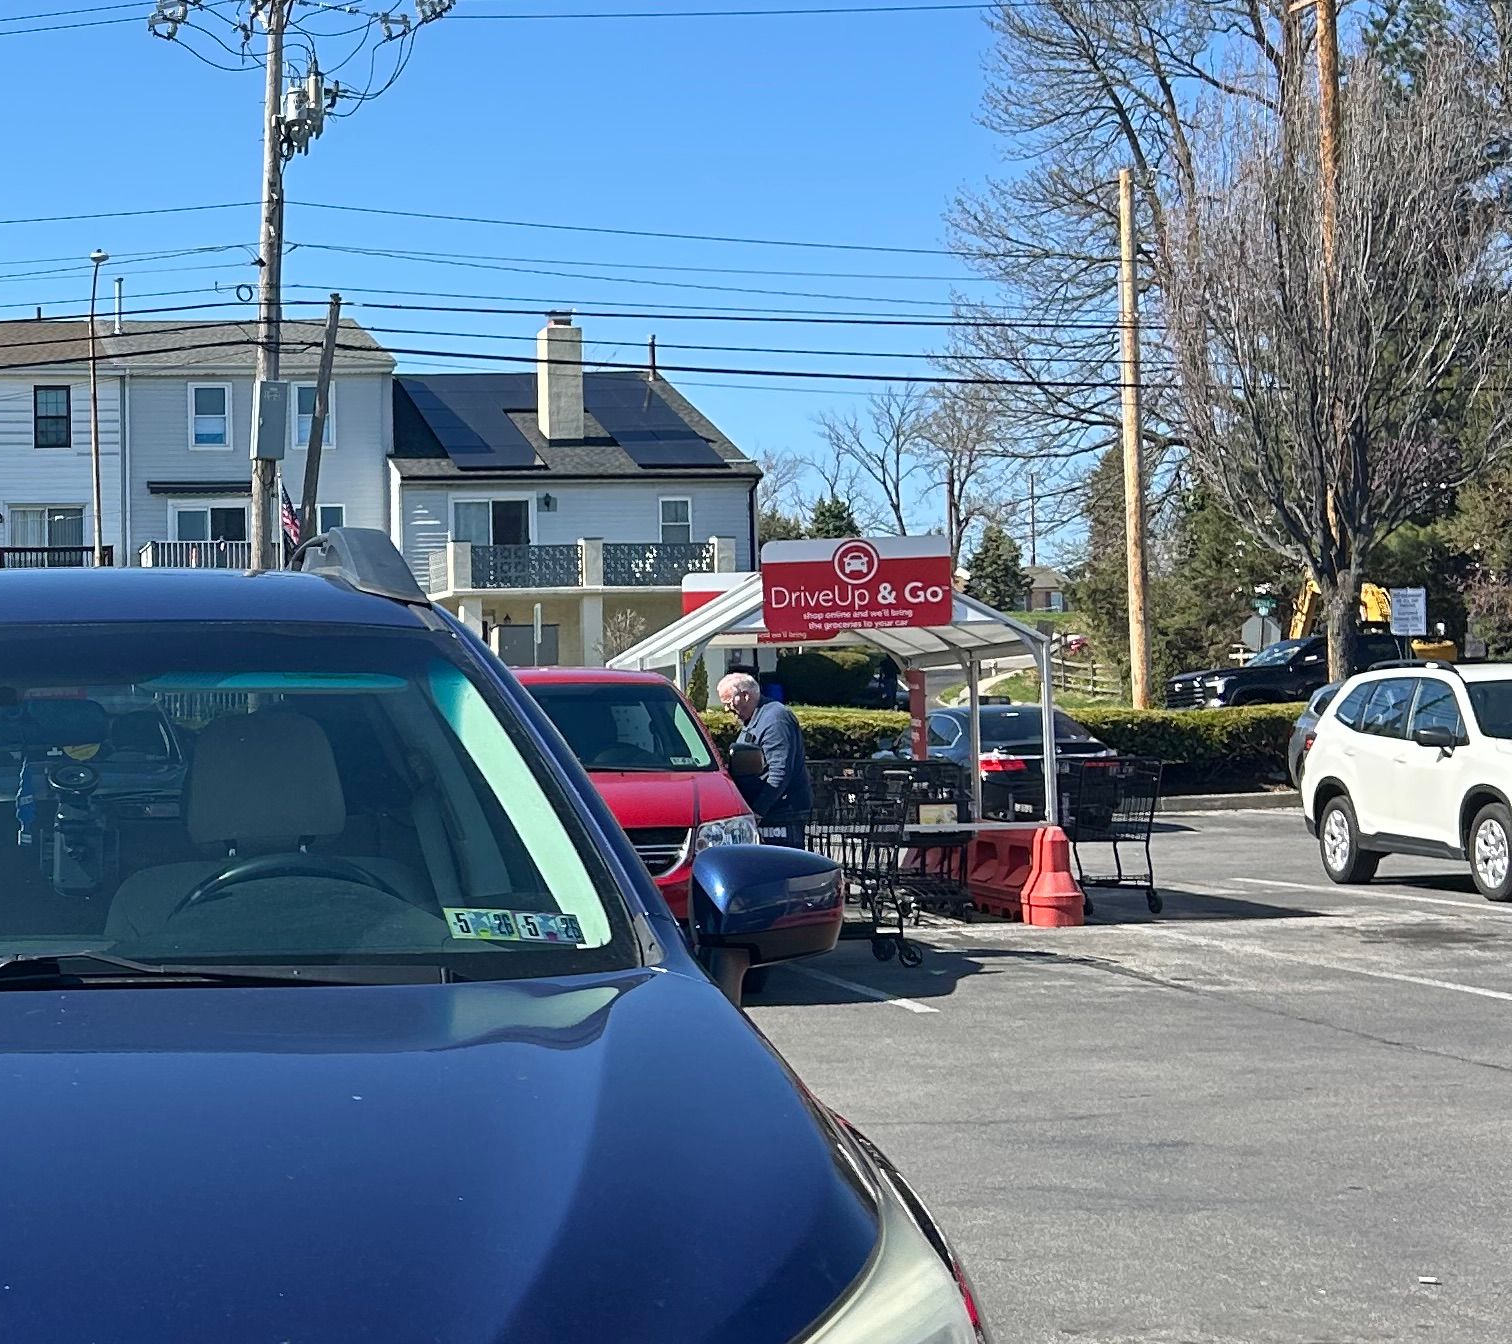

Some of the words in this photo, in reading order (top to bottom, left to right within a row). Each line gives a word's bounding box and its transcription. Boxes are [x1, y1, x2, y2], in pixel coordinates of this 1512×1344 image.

[771, 584, 869, 610] DriveUp
[877, 582, 897, 604] &
[803, 611, 824, 620] shop
[825, 611, 851, 619] online
[853, 610, 868, 618] and
[890, 608, 913, 618] bring
[808, 621, 822, 630] the
[824, 620, 862, 631] groceries
[874, 620, 894, 629] your
[454, 912, 471, 934] 5
[523, 915, 539, 937] 5
